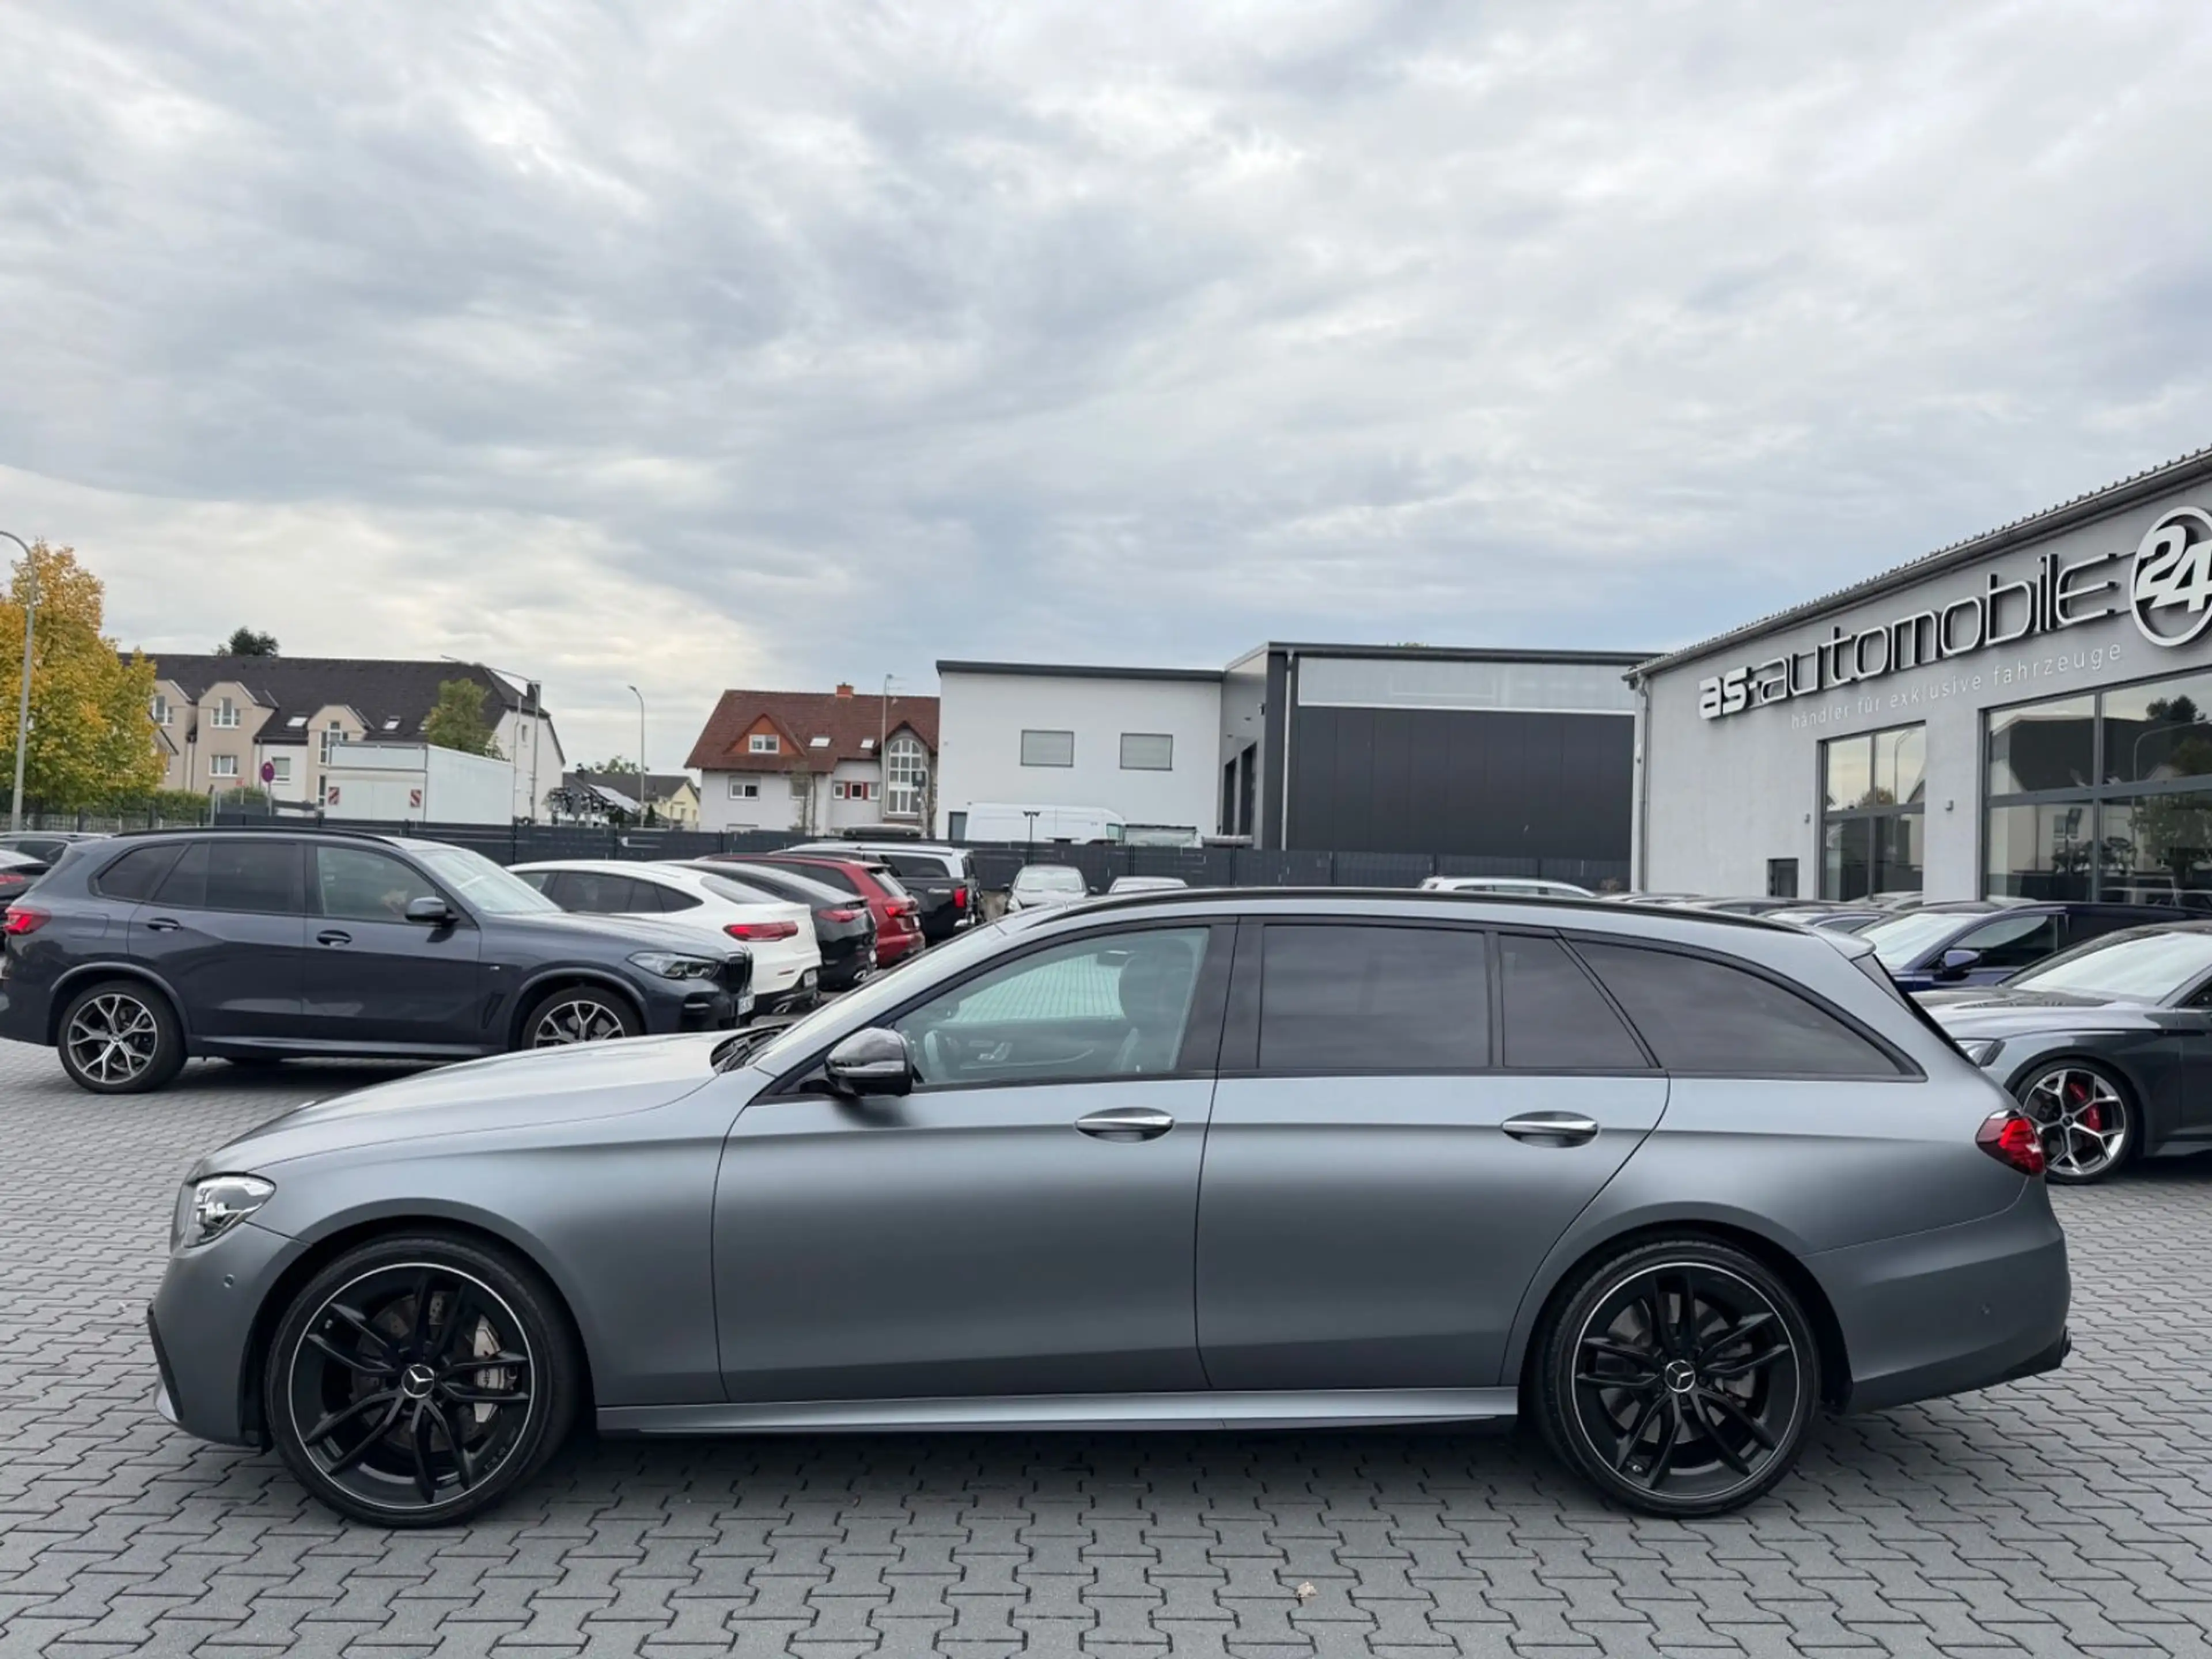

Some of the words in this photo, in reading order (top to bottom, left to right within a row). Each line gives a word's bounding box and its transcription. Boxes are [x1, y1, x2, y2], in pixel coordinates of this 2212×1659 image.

[1791, 704, 1849, 730] händler
[1857, 696, 1881, 714] für
[1889, 675, 1982, 708] exklusive
[1993, 643, 2122, 686] fahrzeuge
